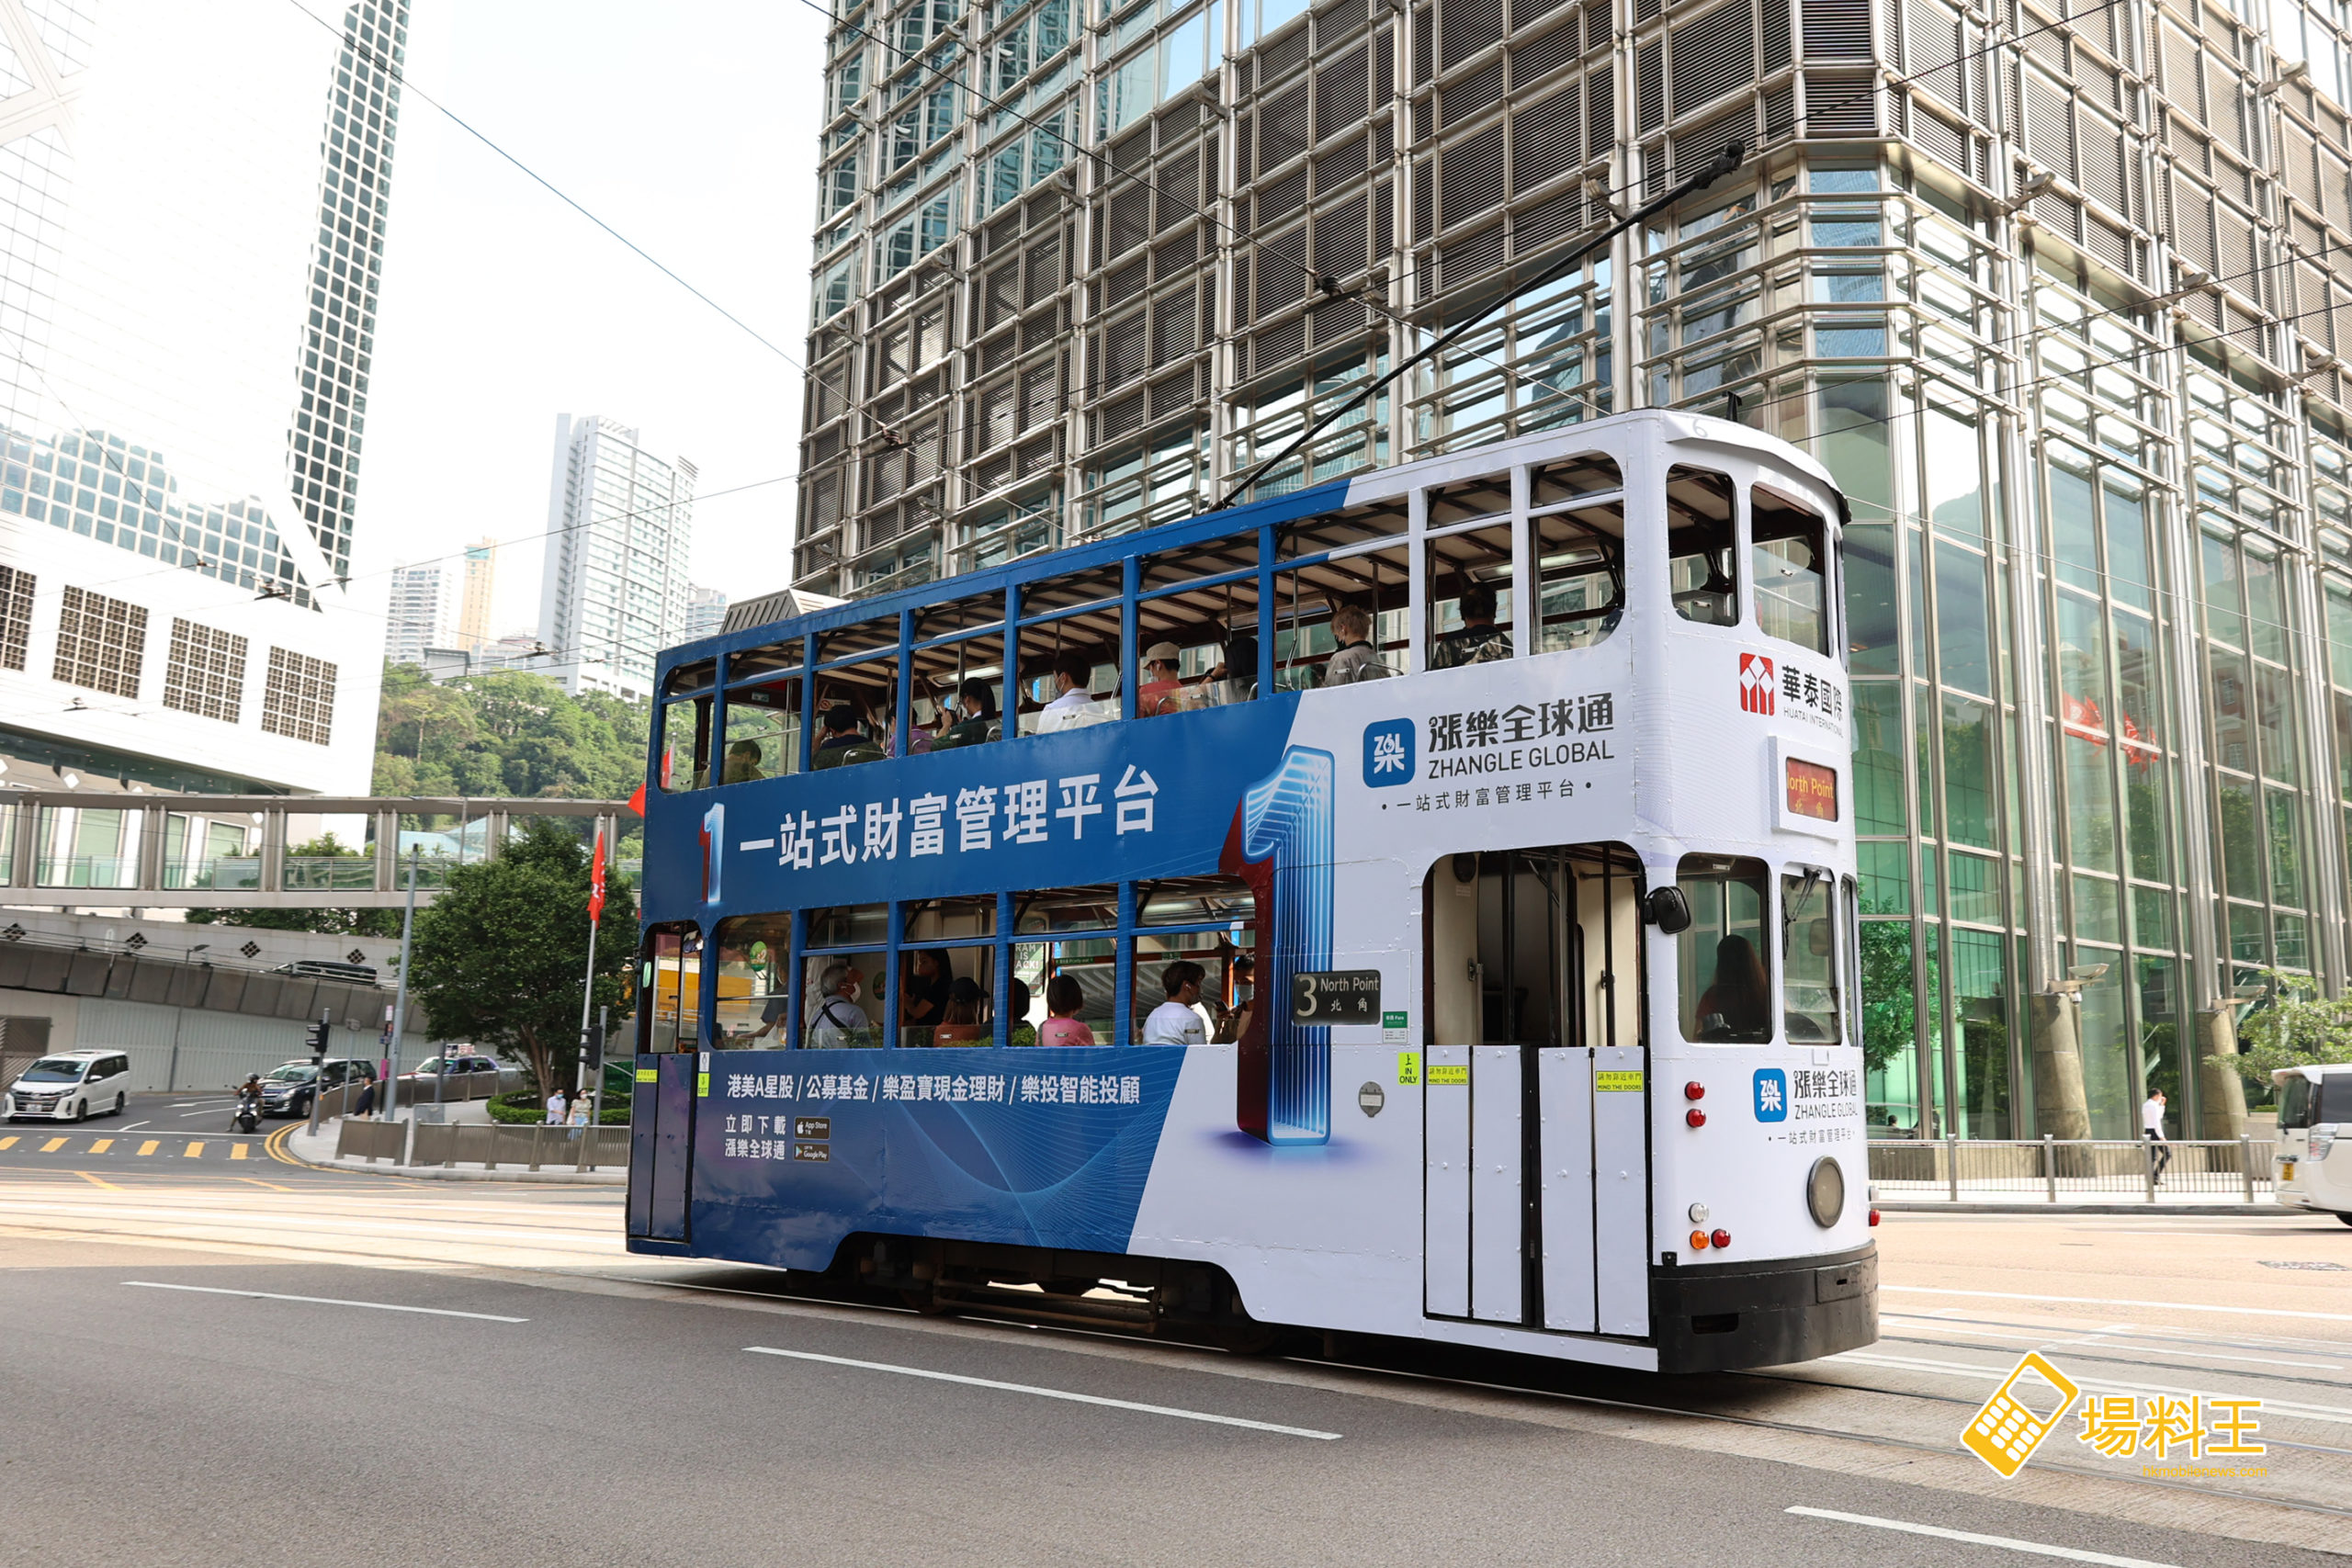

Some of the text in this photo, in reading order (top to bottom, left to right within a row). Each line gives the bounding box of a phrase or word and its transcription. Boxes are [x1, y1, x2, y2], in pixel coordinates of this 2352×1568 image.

[1781, 664, 1842, 721] 華泰國際
[1428, 692, 1615, 753] 漲樂全球通
[1783, 706, 1809, 722] HUATAI
[1428, 739, 1615, 780] ZHANGLE GLOBAL
[1396, 779, 1575, 812] 一站式財富管理平台
[1811, 777, 1834, 799] Point
[739, 764, 1160, 871] 一站式財富管理平台
[1020, 952, 1029, 960] IS
[1320, 976, 1379, 992] North Point
[1296, 975, 1317, 1017] 3
[1331, 998, 1368, 1012] 北角
[727, 1073, 795, 1100] 港美A星股
[806, 1074, 869, 1100] 公募基金
[882, 1074, 1006, 1102] 樂盈寶現金理財
[1021, 1074, 1141, 1105] 樂投智能投顧
[1399, 1076, 1418, 1084] ONLY
[1792, 1069, 1857, 1099] 漲樂全球通
[1794, 1101, 1859, 1120] ZHANGLE GLOBAL
[725, 1113, 786, 1135] 立即下載
[805, 1121, 828, 1131] App Store
[724, 1138, 786, 1161] 漲樂全球通
[803, 1150, 828, 1160] Google Play
